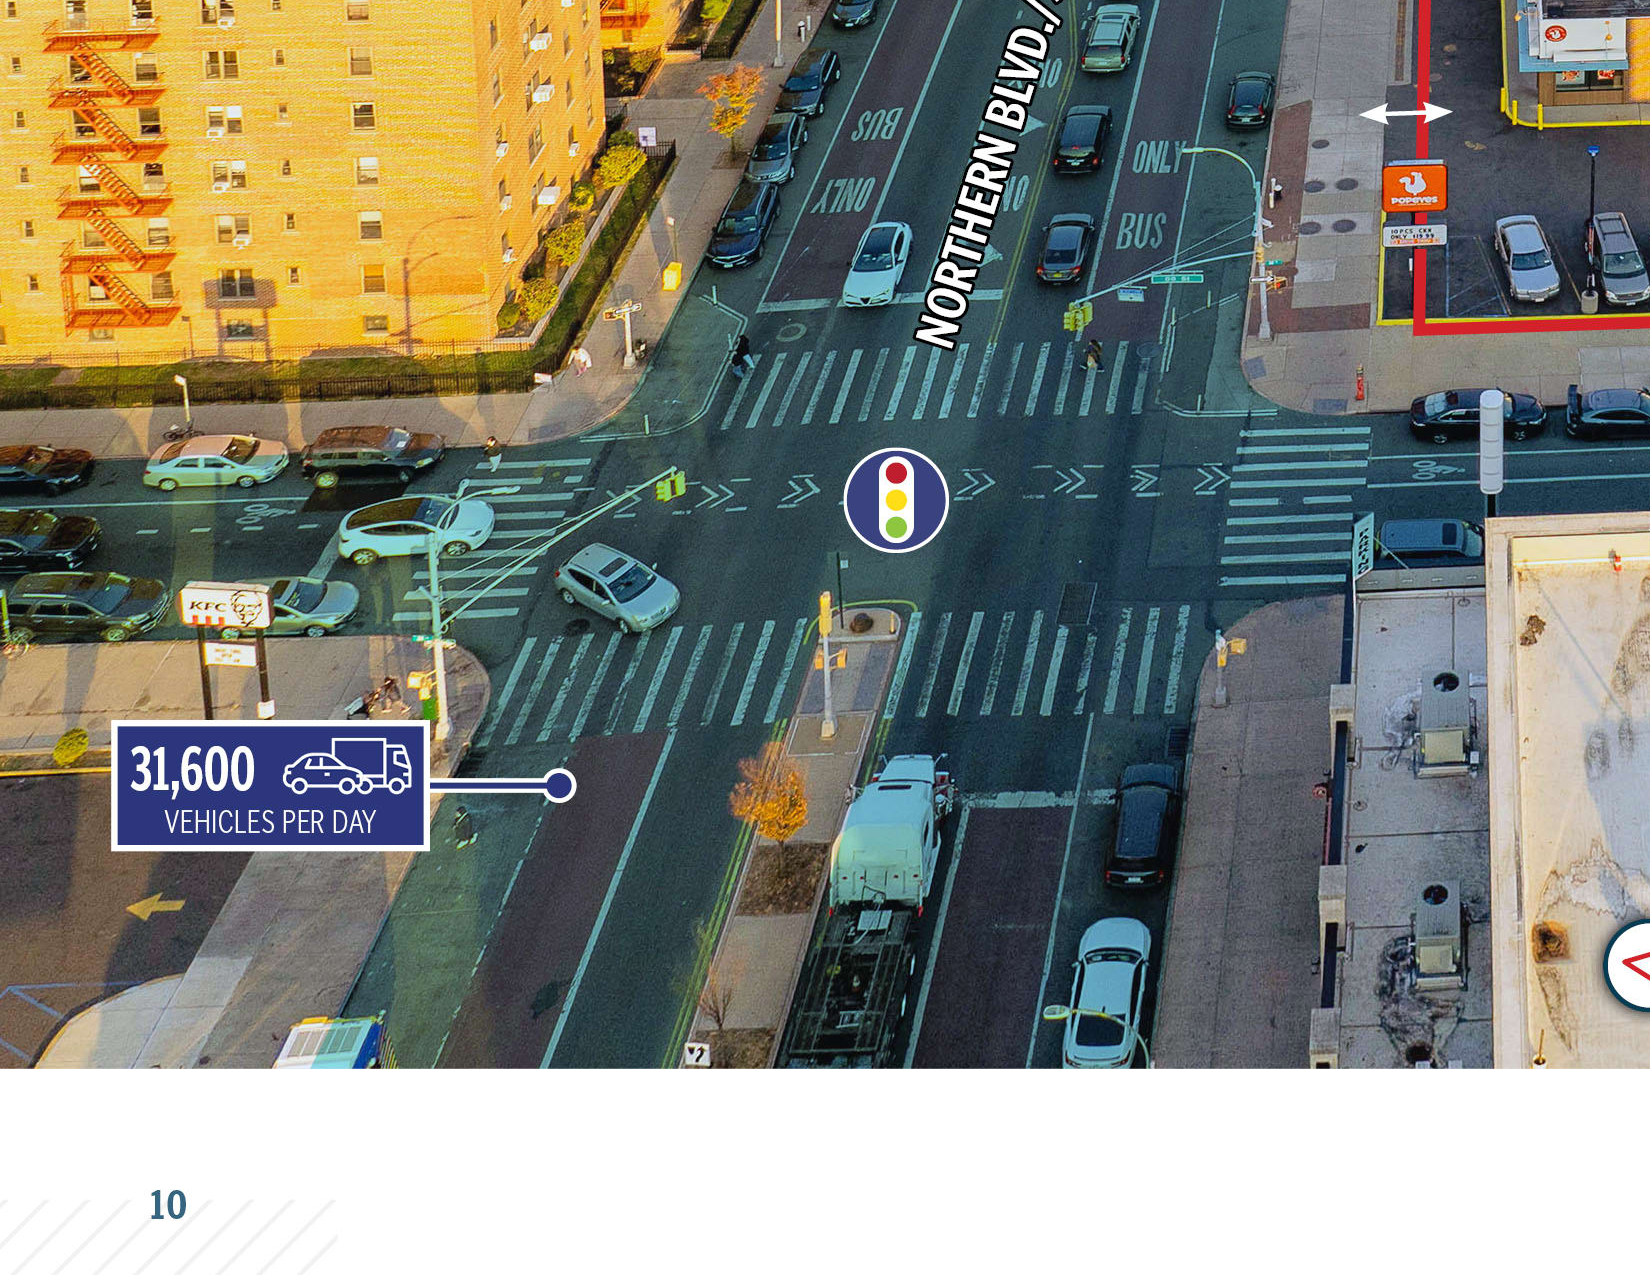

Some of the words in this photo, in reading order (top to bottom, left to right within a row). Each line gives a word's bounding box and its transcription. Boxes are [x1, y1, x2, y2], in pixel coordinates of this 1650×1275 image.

[851, 107, 904, 141] BUS
[1133, 140, 1187, 174] ONLY
[811, 177, 876, 214] ONLY
[1116, 212, 1167, 250] BUS
[190, 601, 227, 612] KFC
